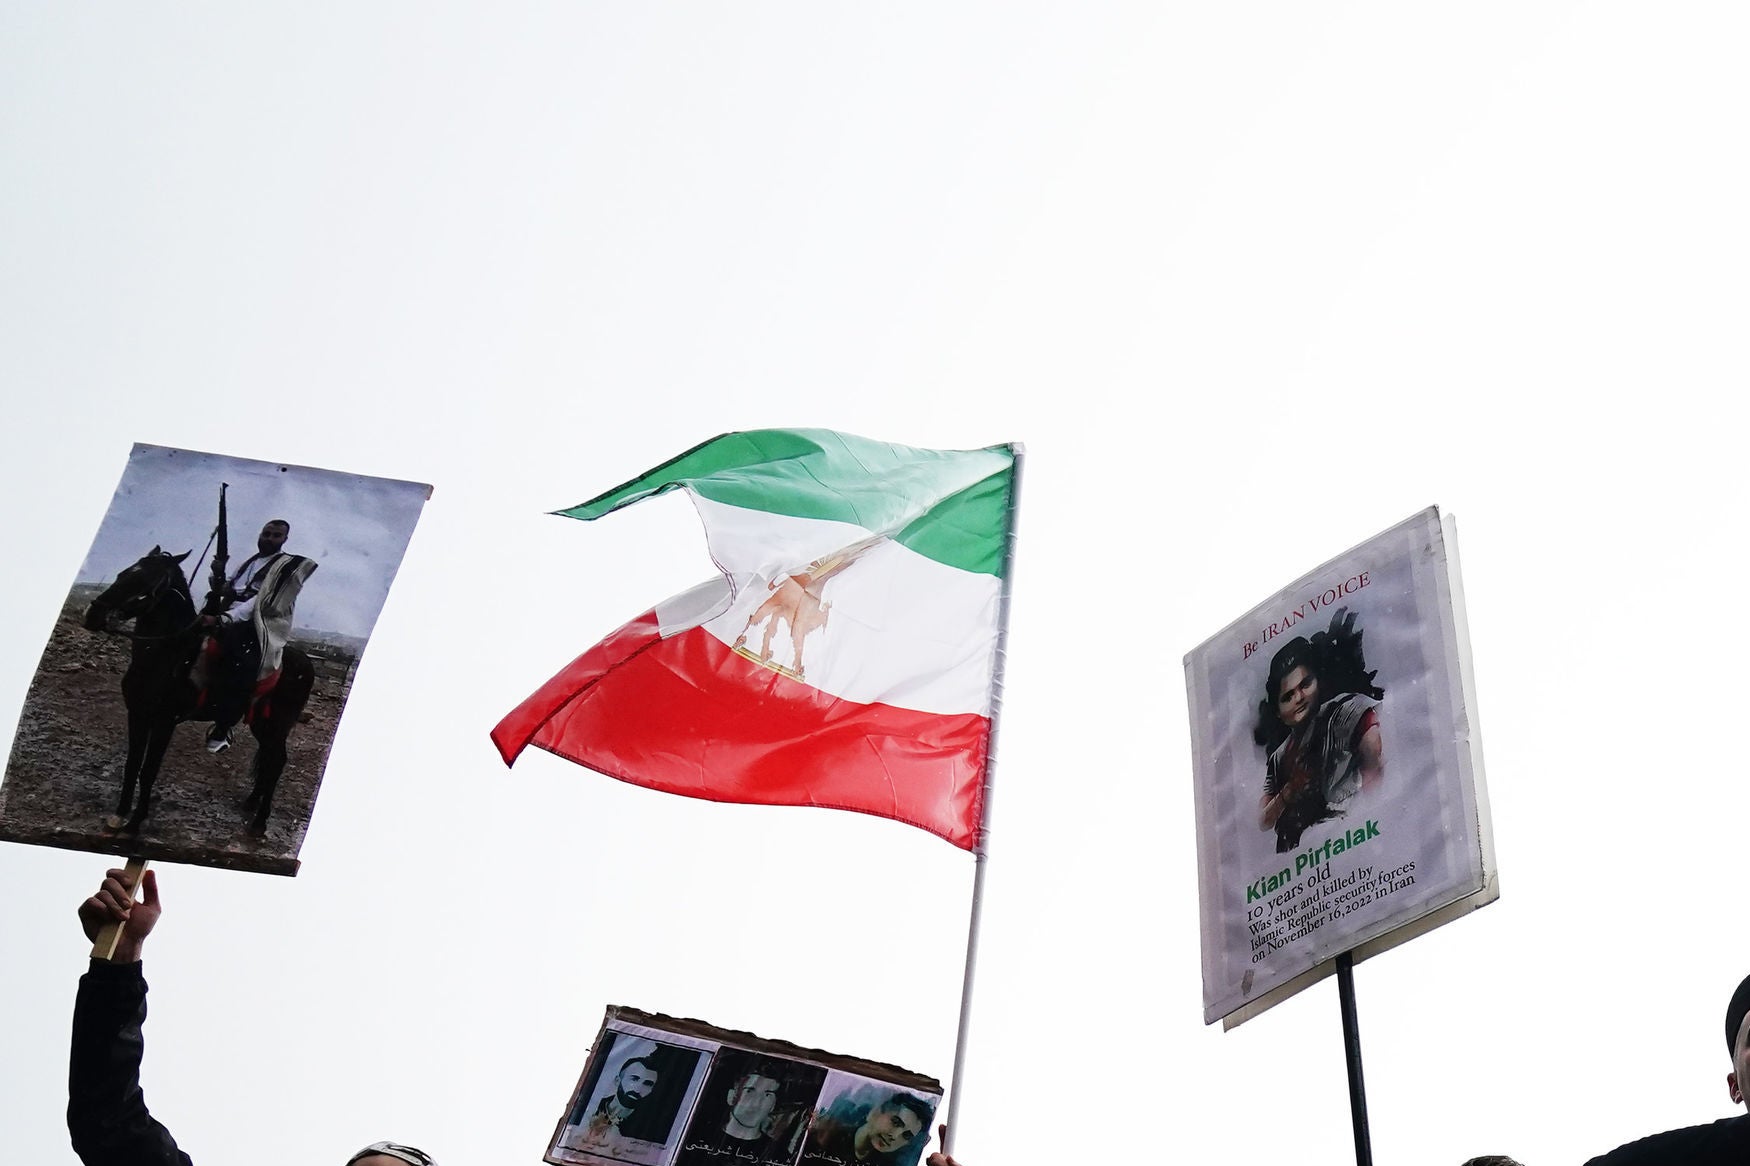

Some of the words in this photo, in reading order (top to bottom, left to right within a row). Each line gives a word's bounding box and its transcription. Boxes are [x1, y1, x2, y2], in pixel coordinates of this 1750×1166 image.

[1243, 641, 1259, 660] Be
[1262, 604, 1305, 644] IRAN
[1308, 571, 1371, 613] VOICE
[1246, 868, 1292, 904] Kian
[1295, 819, 1381, 876] Pirfalak
[1248, 906, 1264, 922] 10
[1267, 883, 1304, 917] years
[1307, 862, 1331, 888] old
[1249, 921, 1272, 936] Was
[1275, 904, 1299, 924] shot
[1300, 891, 1320, 910] and
[1322, 872, 1356, 899] killed
[1358, 865, 1374, 880] by
[1250, 926, 1284, 951] Islamic
[1288, 901, 1331, 931] Republic
[1334, 878, 1377, 906] security
[1377, 861, 1416, 886] forces
[1251, 952, 1266, 964] on
[1267, 917, 1325, 956] November
[1375, 887, 1389, 900] in
[1389, 875, 1416, 895] Iran
[685, 1140, 733, 1156] شریعتی
[736, 1147, 760, 1164] رضا
